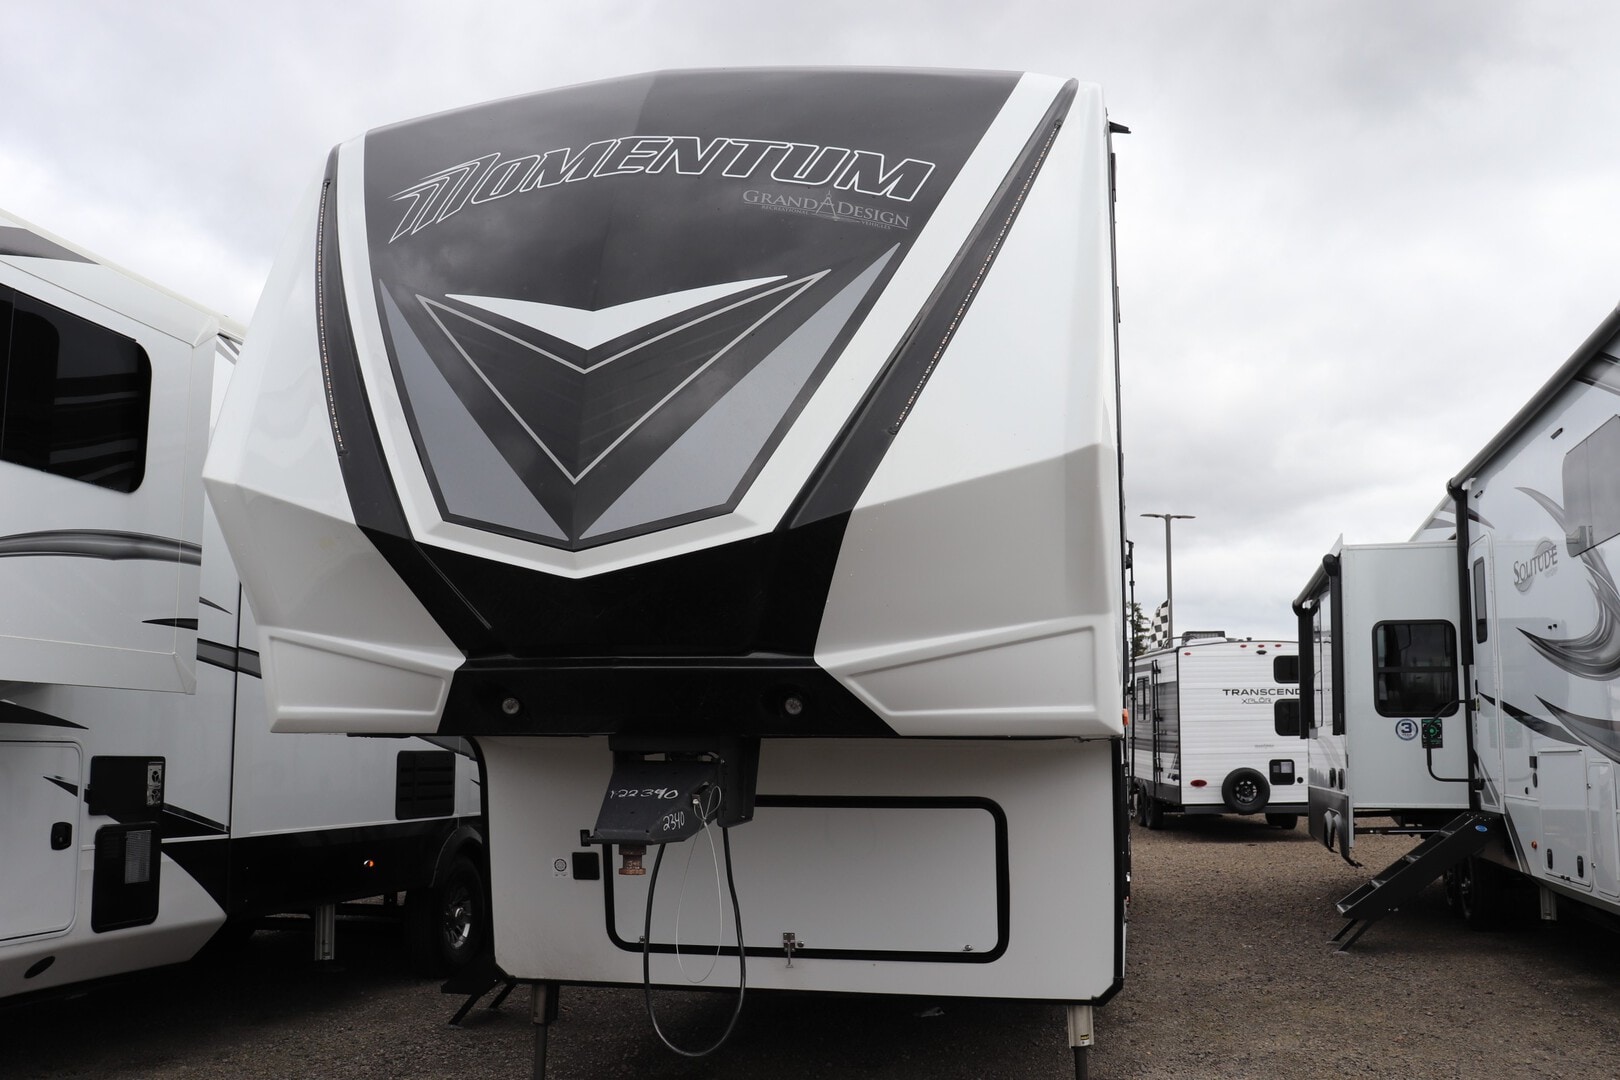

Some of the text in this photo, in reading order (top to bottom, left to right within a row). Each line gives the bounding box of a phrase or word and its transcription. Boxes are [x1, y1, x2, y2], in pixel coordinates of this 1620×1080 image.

[387, 135, 936, 244] MOMENTUM
[742, 189, 909, 227] GRAND DESIGN
[1513, 544, 1558, 585] SOLITUDE
[1401, 722, 1412, 734] 3
[662, 811, 685, 831] 2340
